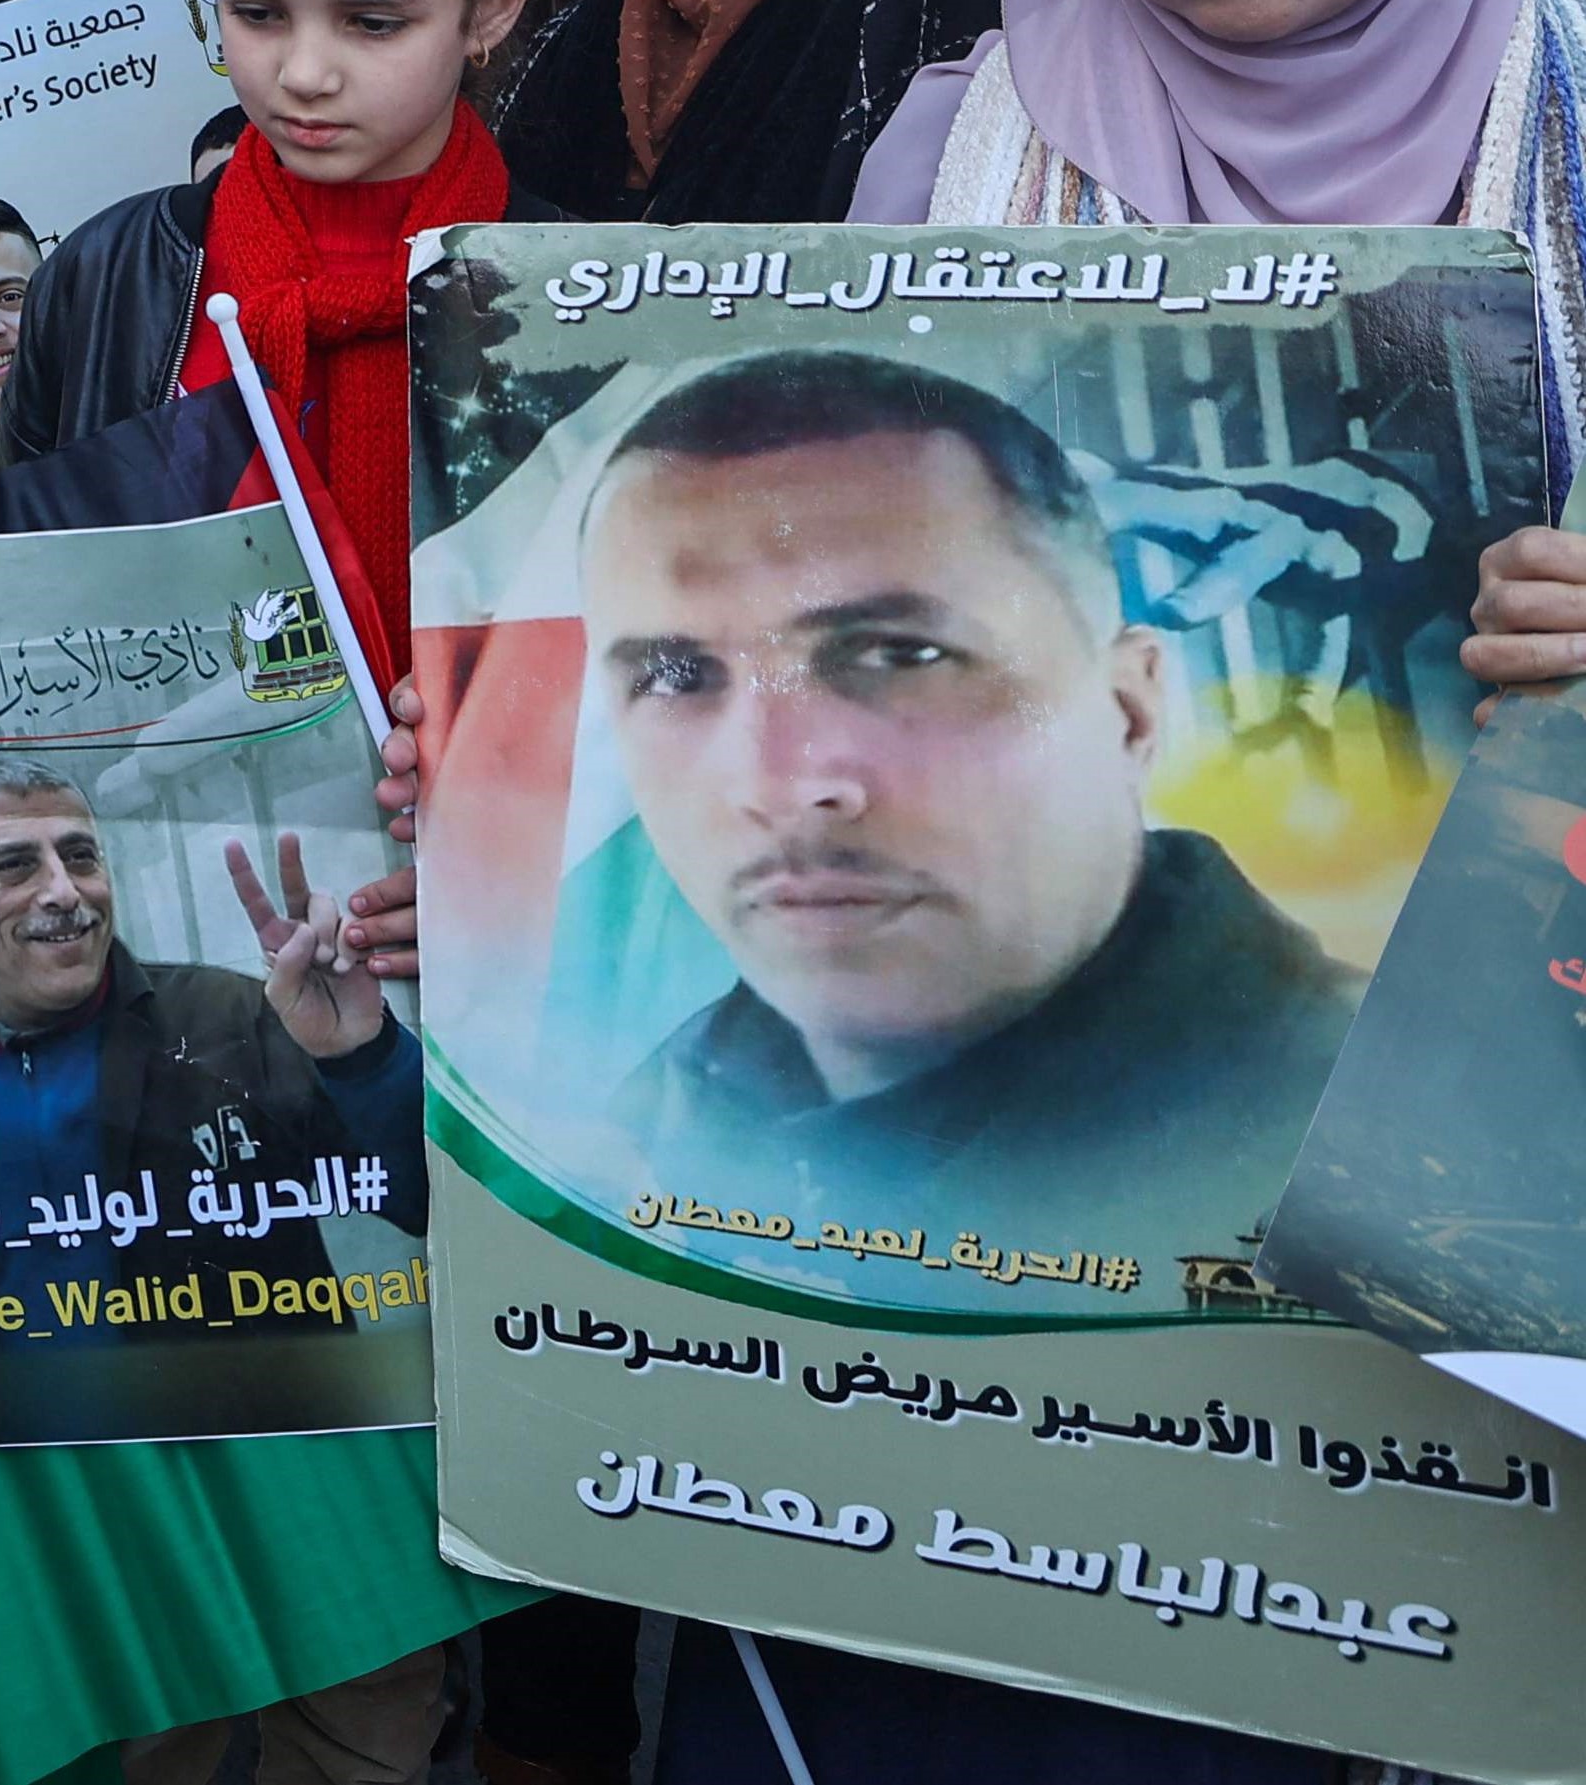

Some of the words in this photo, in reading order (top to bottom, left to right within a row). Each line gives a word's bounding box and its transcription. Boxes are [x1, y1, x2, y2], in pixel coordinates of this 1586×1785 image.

[45, 1, 146, 51] جمعية
[44, 52, 160, 108] Society
[489, 1299, 785, 1384] السرطان
[799, 1348, 1020, 1422] مريض
[1031, 1392, 1275, 1465] الأسير
[574, 1445, 894, 1555] معطان
